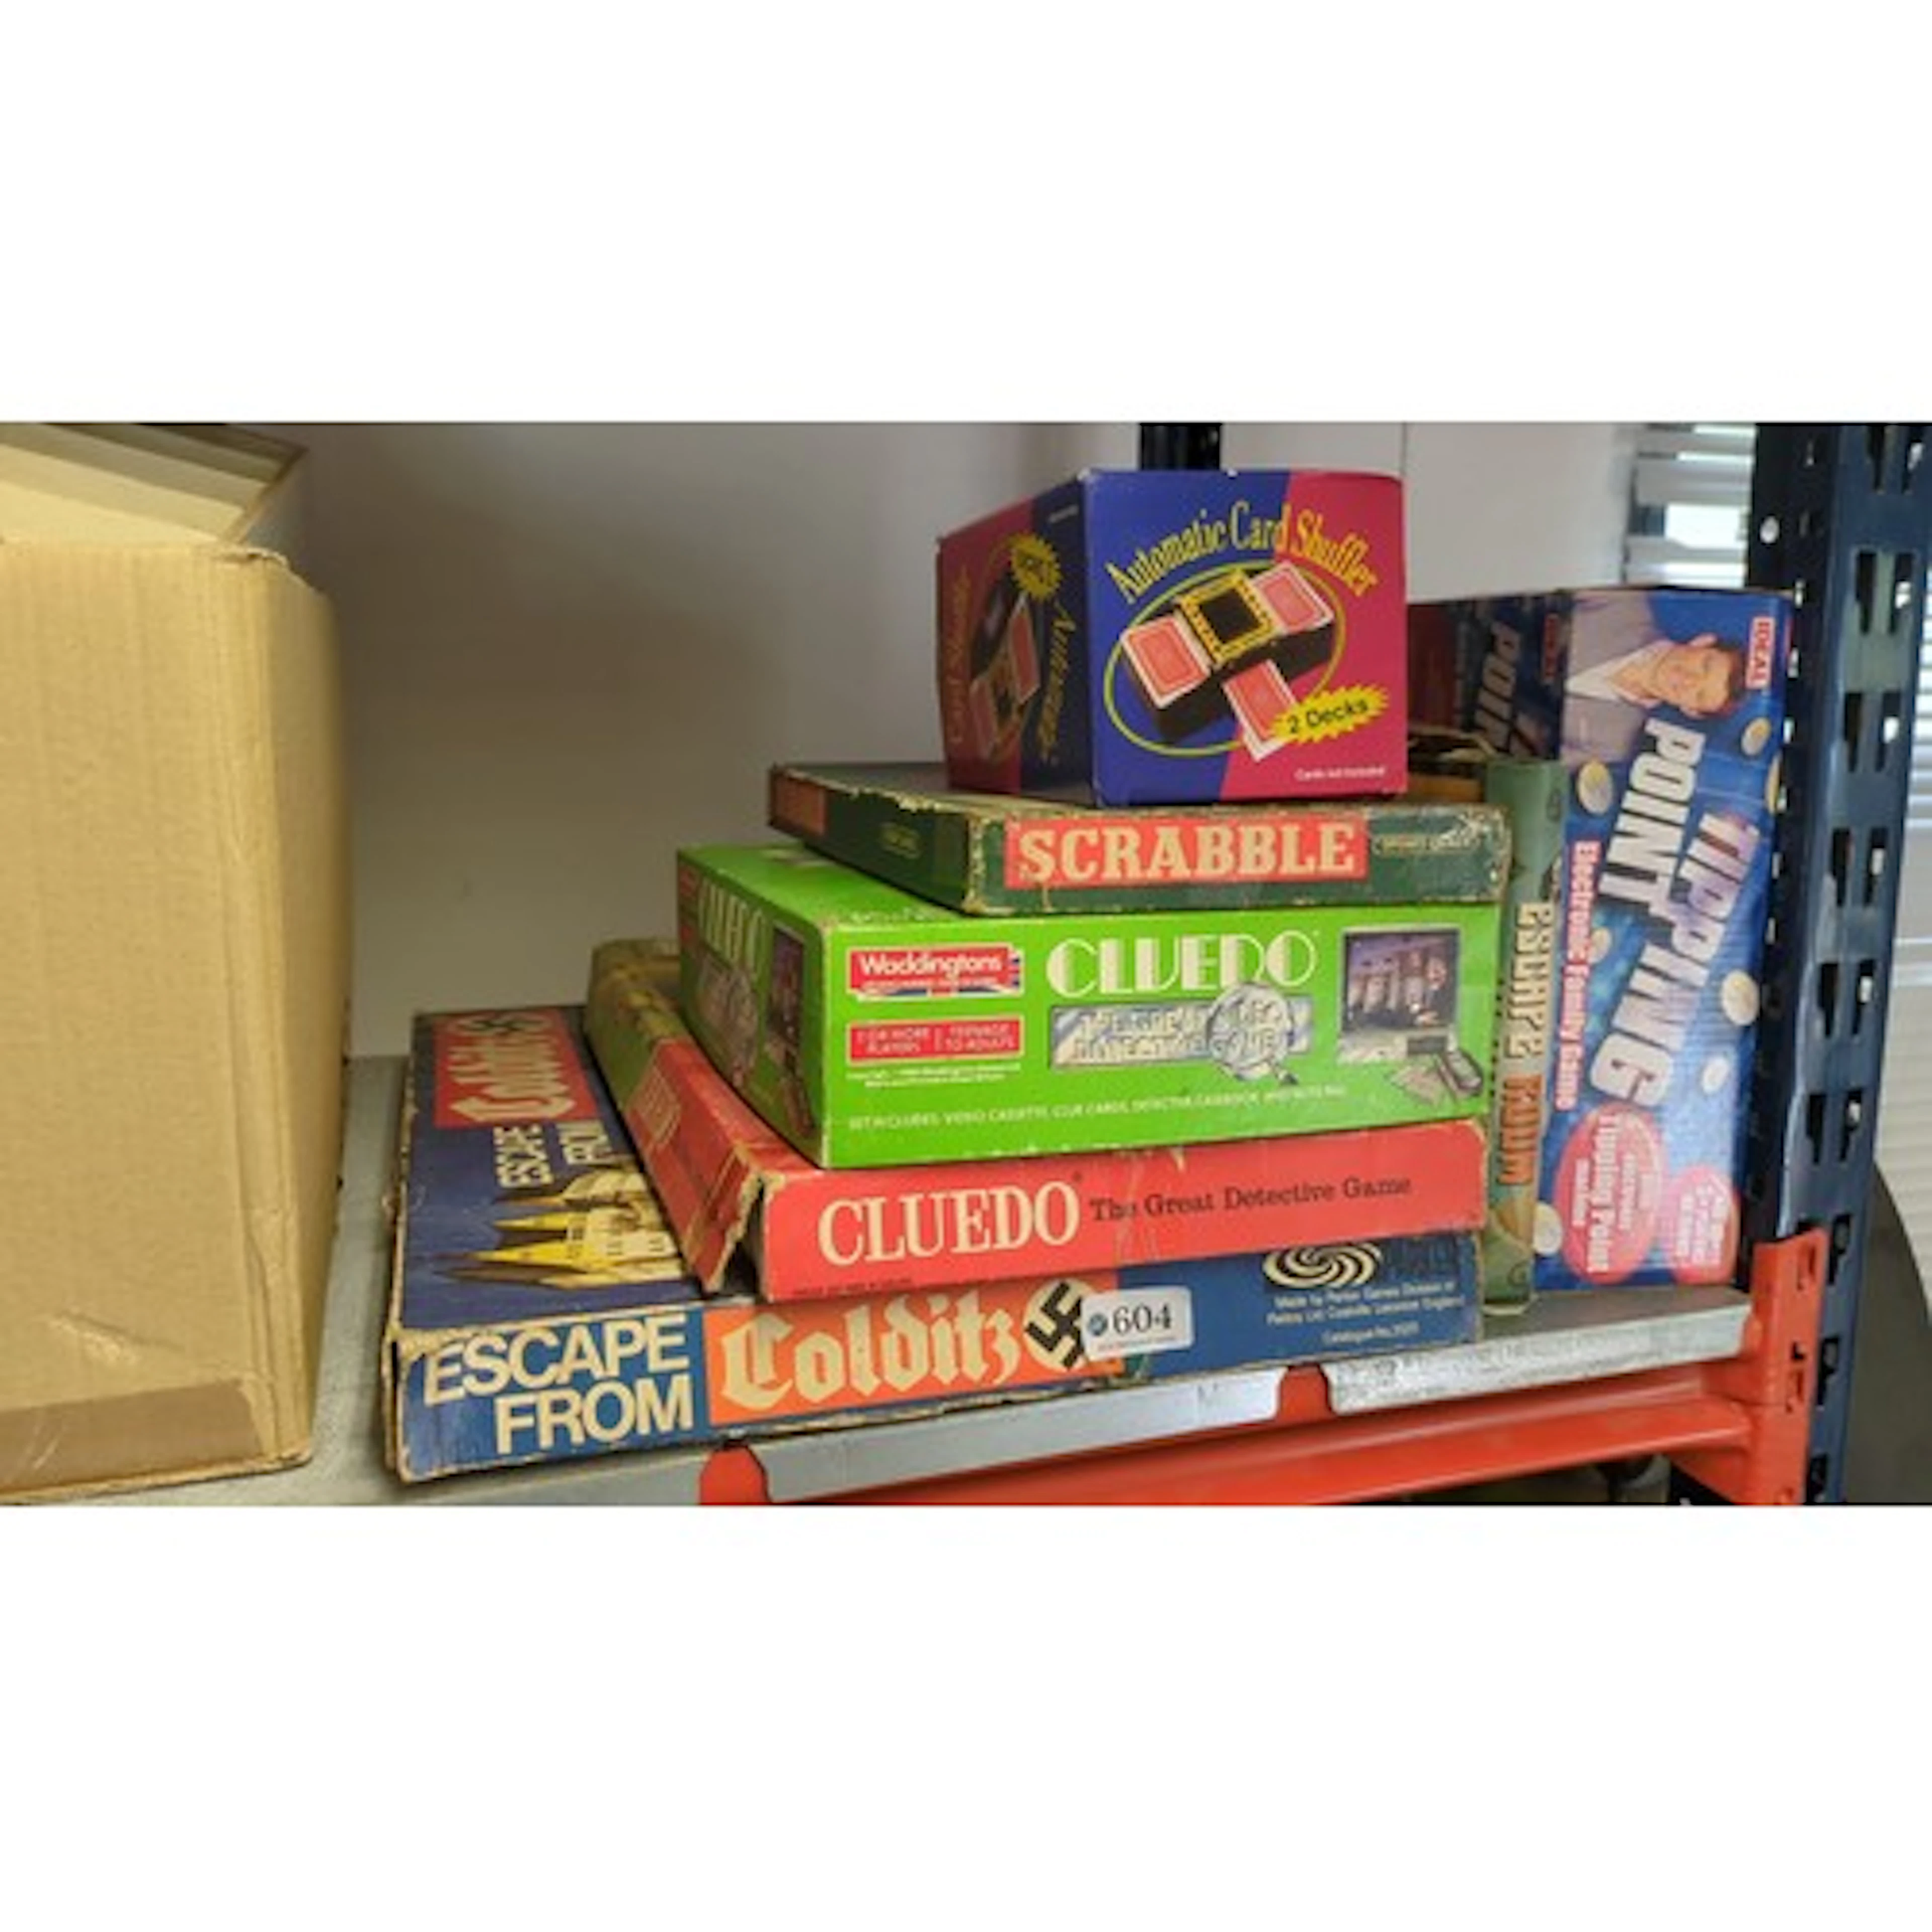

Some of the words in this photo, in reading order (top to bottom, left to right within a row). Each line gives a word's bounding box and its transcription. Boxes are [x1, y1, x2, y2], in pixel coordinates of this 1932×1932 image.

[1104, 507, 1227, 604] Automatic
[1231, 501, 1292, 551] Card
[1295, 508, 1379, 597] Shuffler
[1749, 620, 1770, 683] IDEAL
[1288, 715, 1300, 735] 2
[1305, 698, 1371, 730] Decks
[1598, 717, 1706, 904] POINT
[1020, 823, 1355, 883] SCRABBLE
[1568, 840, 1601, 963] Electronic
[858, 950, 1002, 980] Waddingtons
[1046, 930, 1317, 999] CLUEDO
[1509, 902, 1553, 1063] ESCAPE
[1590, 811, 1759, 1106] TIPPING
[1560, 964, 1590, 1040] Family
[1555, 1041, 1583, 1109] Game
[1499, 1074, 1542, 1184] ROOM
[1590, 1114, 1622, 1206] Tipping
[818, 1180, 1079, 1265] CLUEDO
[1090, 1196, 1137, 1222] The
[1144, 1188, 1214, 1218] Great
[1224, 1177, 1337, 1209] Detective
[1345, 1175, 1410, 1197] Game
[1586, 1208, 1616, 1273] Point
[424, 1312, 689, 1407] ESCAPE
[720, 1290, 1020, 1410] Colditz
[1113, 1303, 1171, 1335] 604
[496, 1375, 693, 1454] FROM
